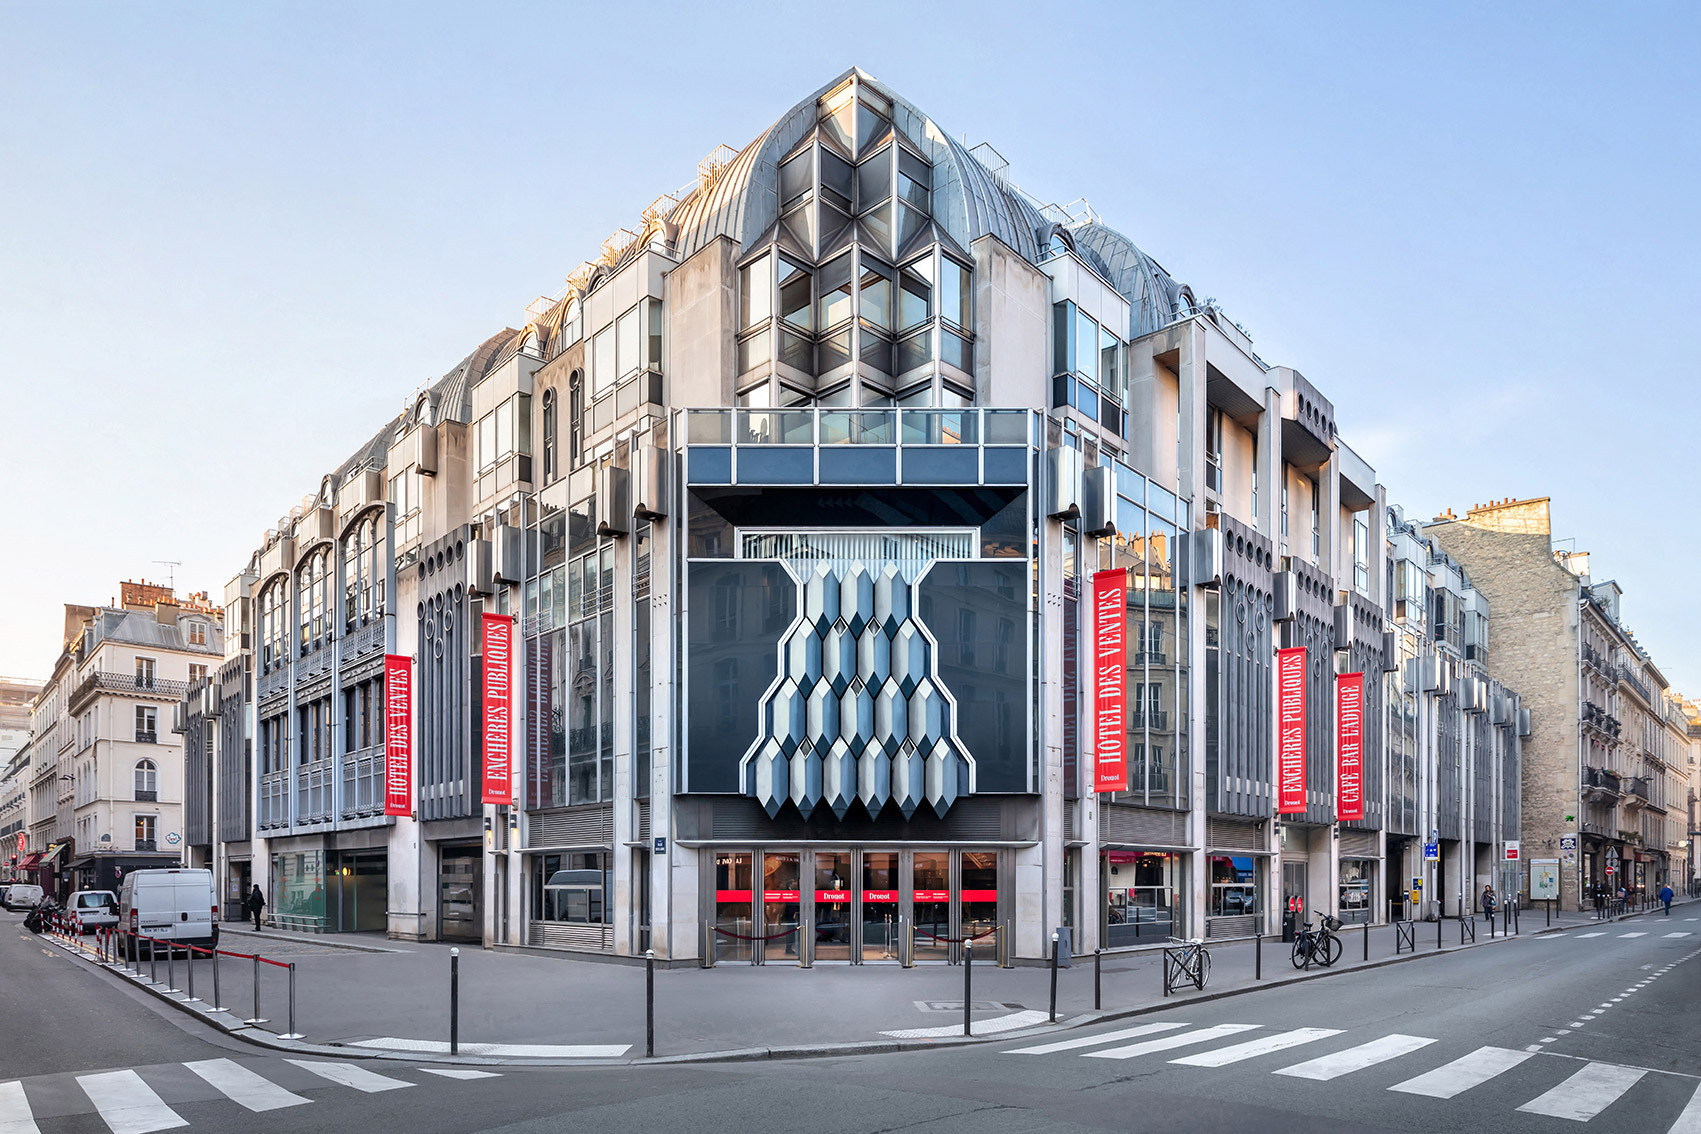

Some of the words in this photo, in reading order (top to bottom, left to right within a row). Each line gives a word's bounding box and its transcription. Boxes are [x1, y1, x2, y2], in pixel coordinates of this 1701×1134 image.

[1098, 587, 1122, 659] VENTES
[486, 622, 508, 700] PUBLIQUES
[1099, 664, 1122, 700] DES
[389, 668, 408, 718] VENTES
[1282, 654, 1302, 722] PUBLIQUES
[1340, 685, 1361, 737] L'ADJUGÉ
[389, 724, 408, 749] DES
[486, 706, 508, 781] ENCHÈRES
[1098, 705, 1122, 765] HÔTEL
[1341, 743, 1360, 766] BAR
[388, 752, 408, 796] HÔTEL
[1101, 774, 1119, 782] Drouot
[1281, 727, 1302, 793] ENCHÈRES
[1340, 772, 1360, 802] CAFÉ
[823, 892, 845, 900] Drouot
[869, 892, 890, 900] Drouot
